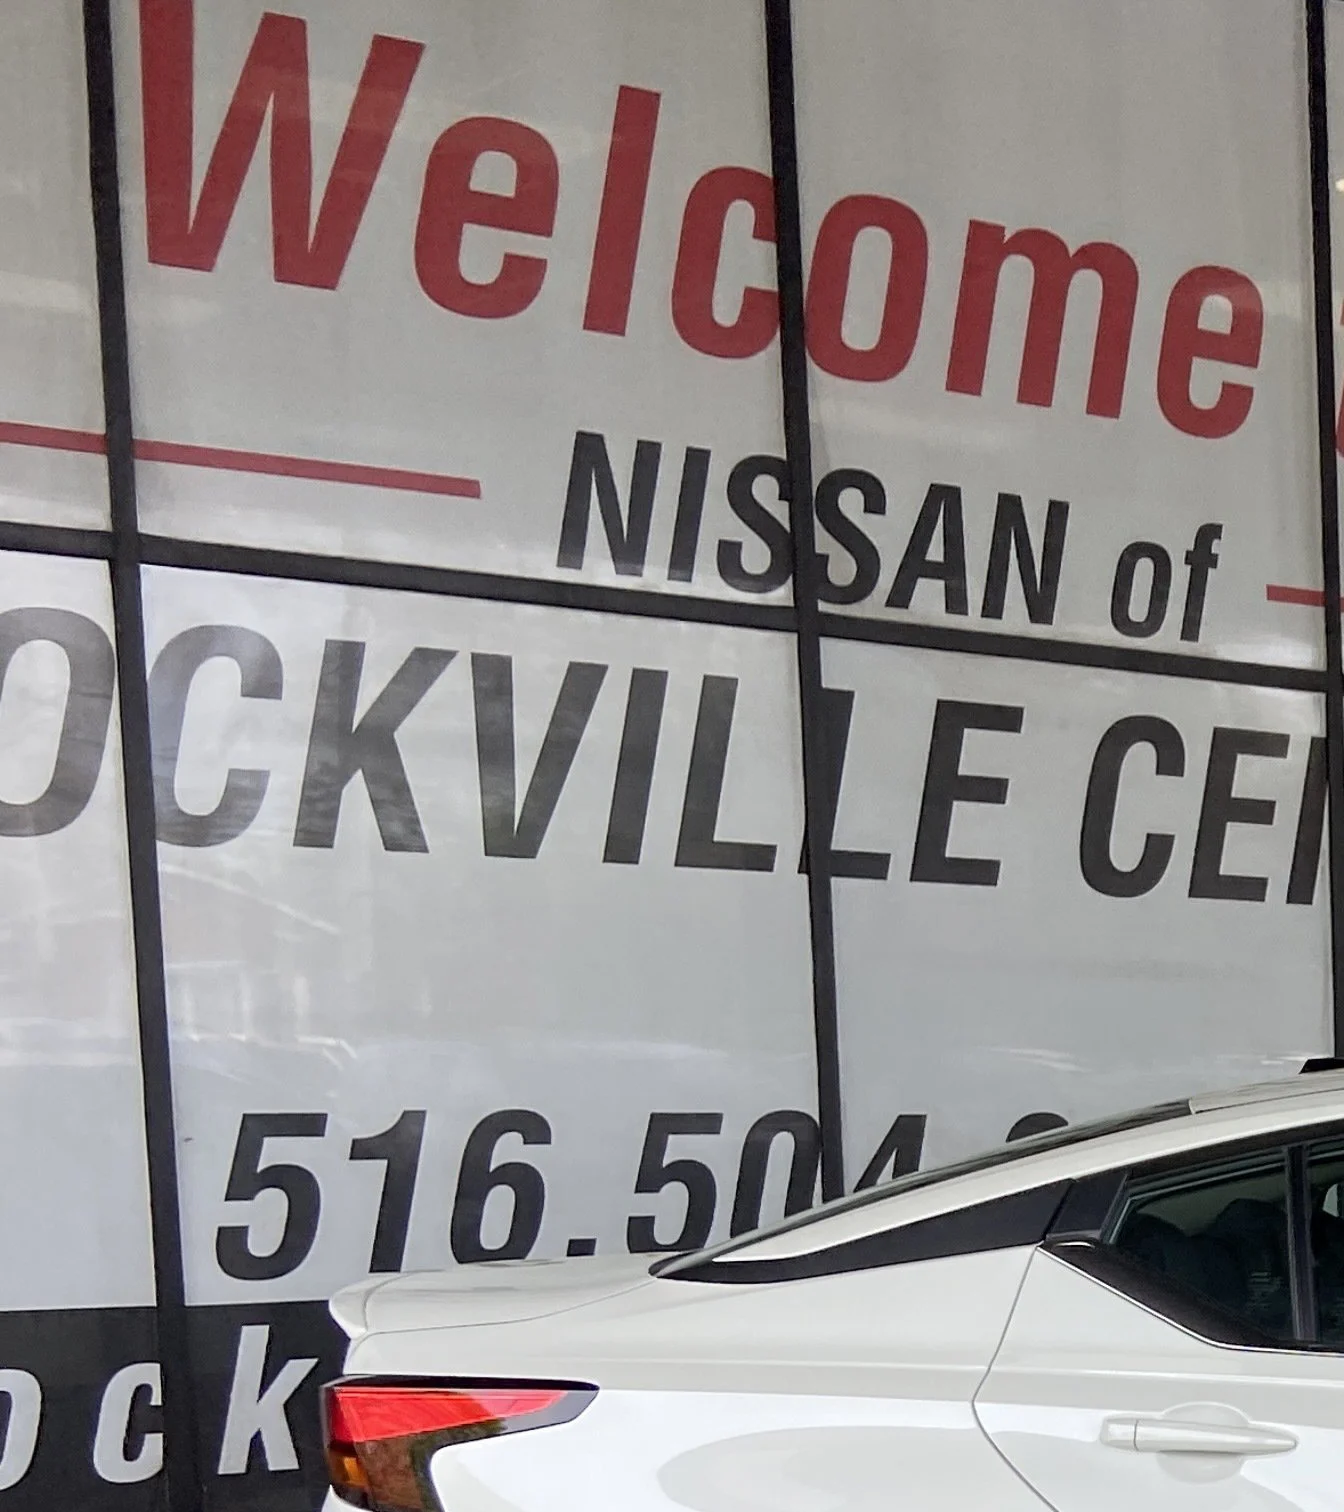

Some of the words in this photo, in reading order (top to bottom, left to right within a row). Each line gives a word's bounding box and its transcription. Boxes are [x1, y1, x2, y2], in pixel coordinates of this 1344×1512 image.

[138, 0, 1265, 439] Welcome
[556, 430, 1070, 625] NISSAN
[1110, 523, 1223, 642] of
